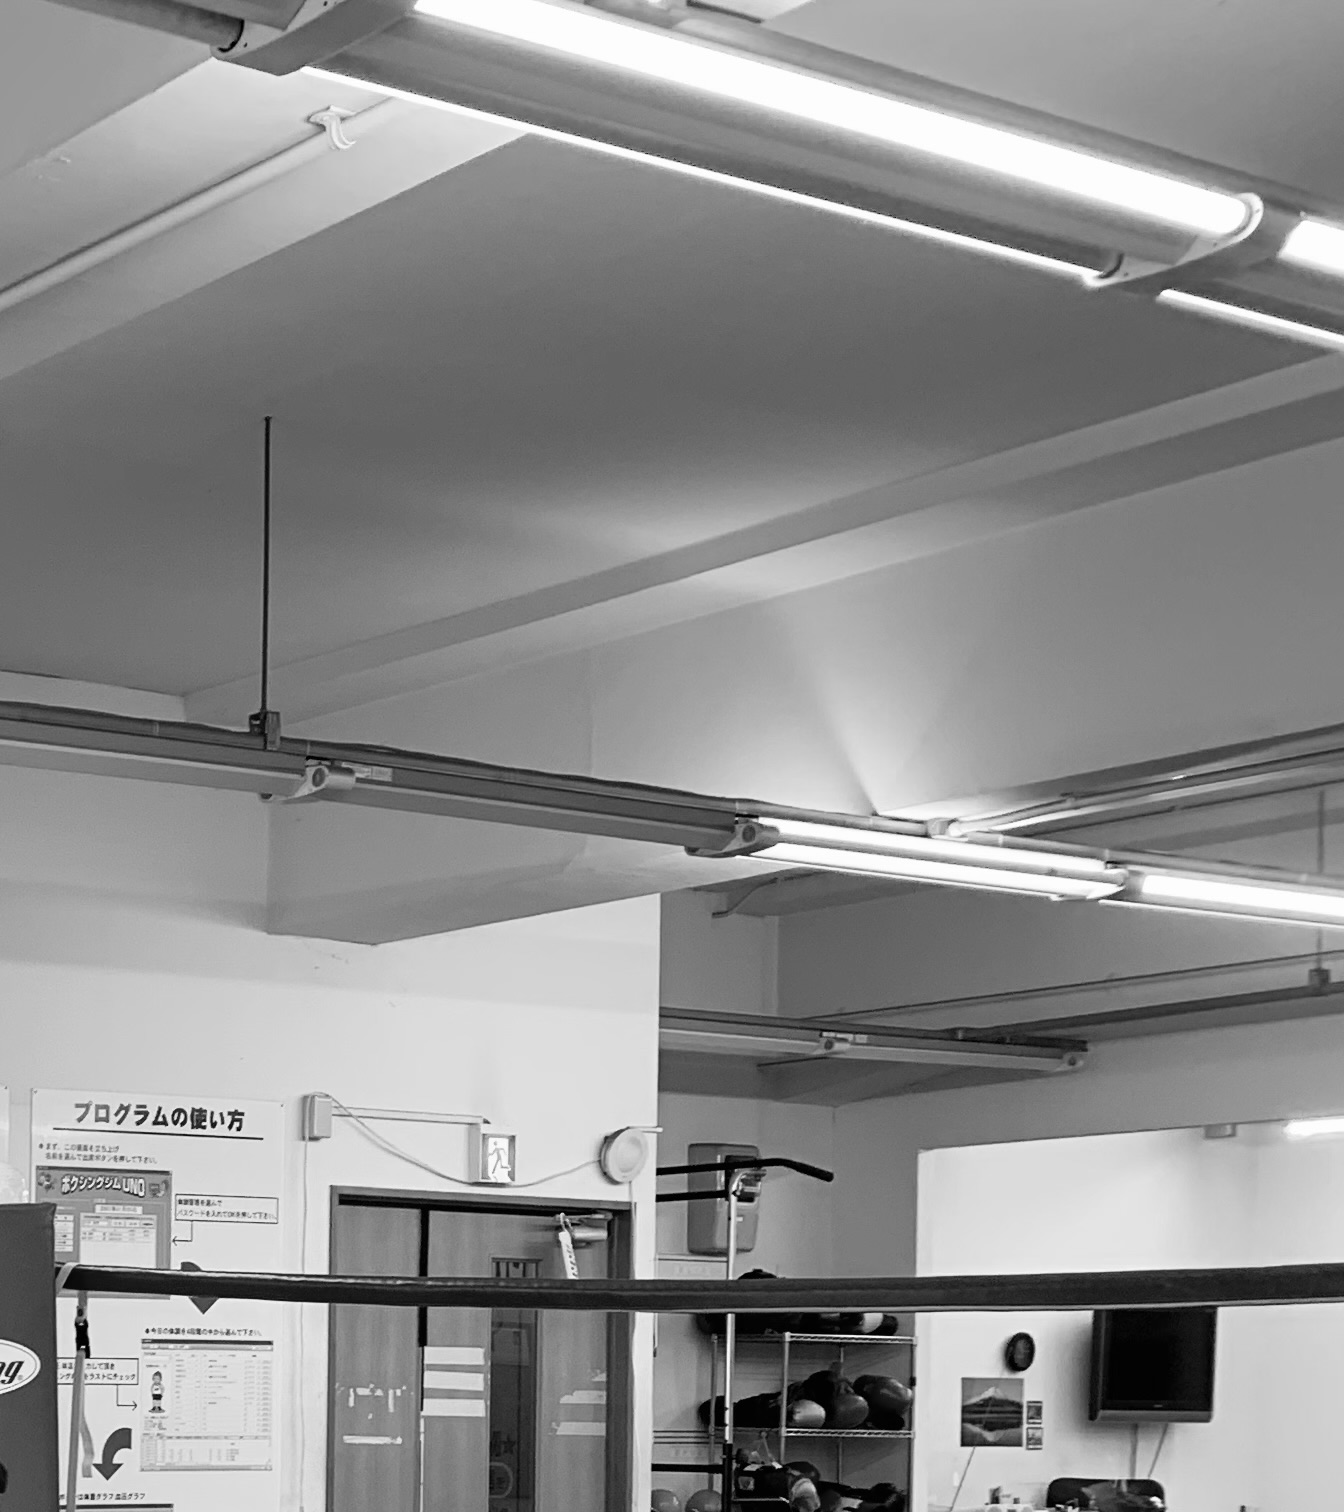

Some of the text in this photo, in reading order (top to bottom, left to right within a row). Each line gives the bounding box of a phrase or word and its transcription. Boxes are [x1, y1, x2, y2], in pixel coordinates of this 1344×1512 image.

[75, 1101, 245, 1132] プログラムの使い方
